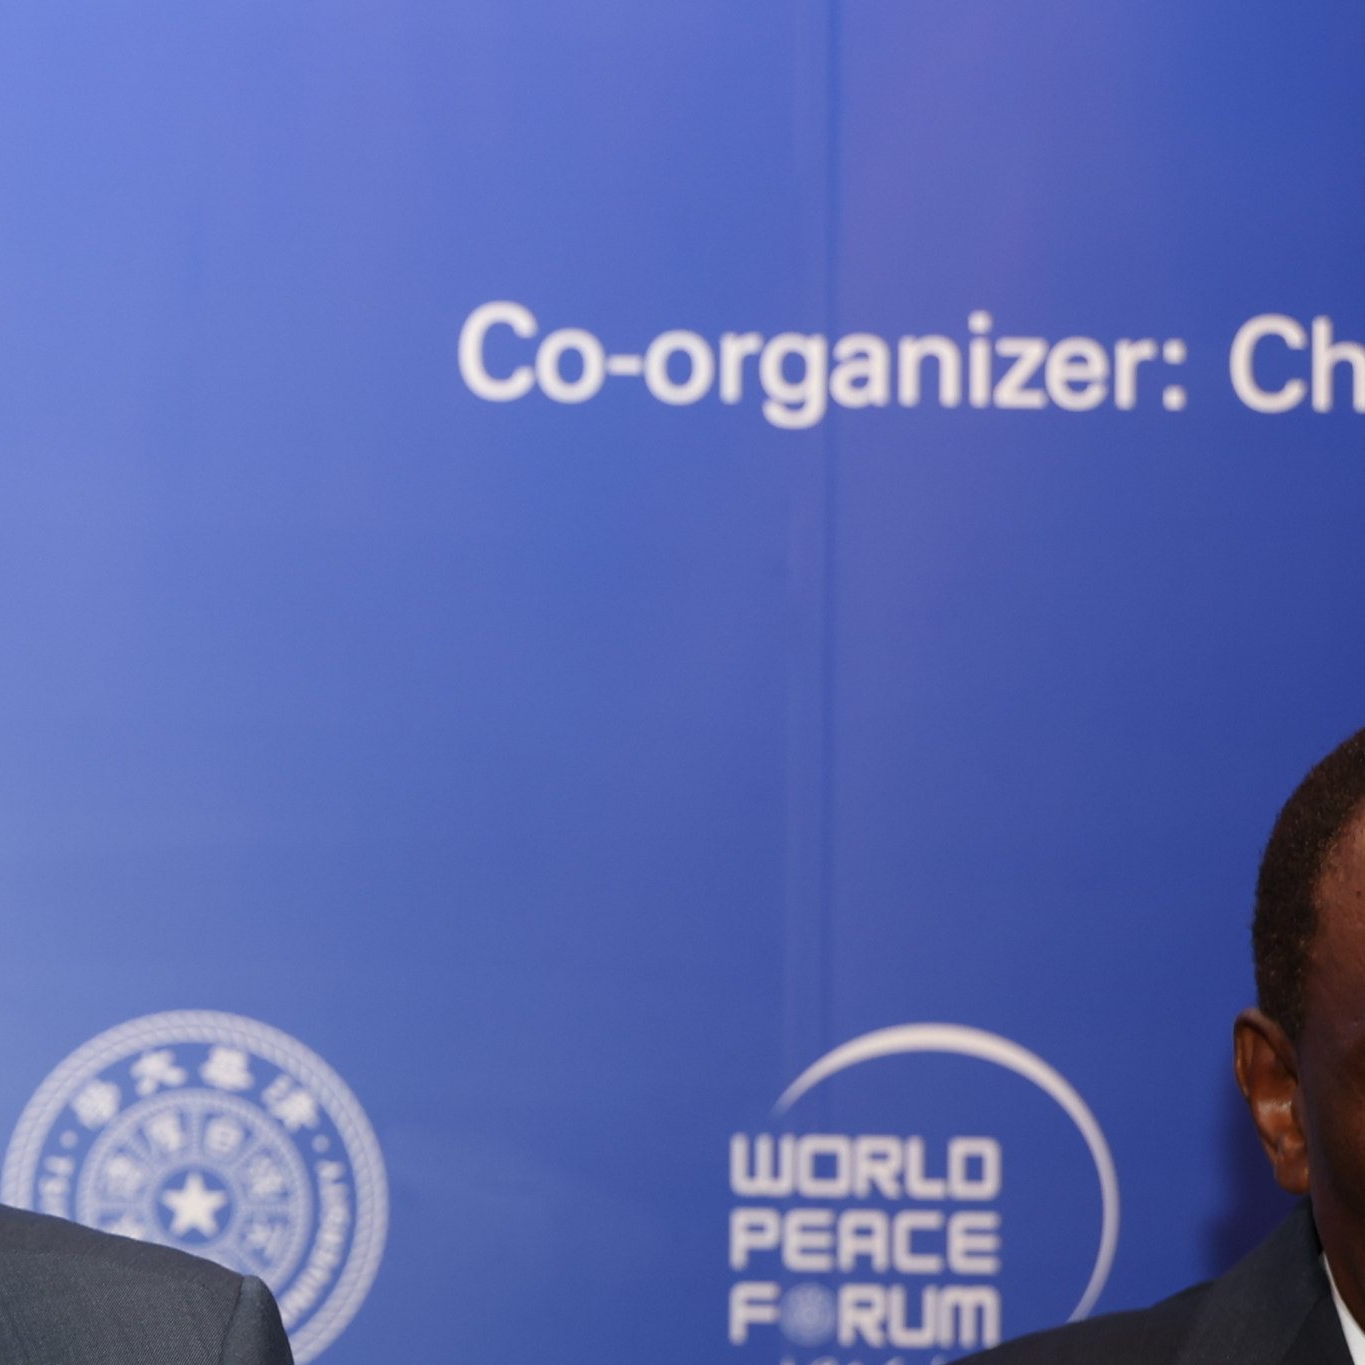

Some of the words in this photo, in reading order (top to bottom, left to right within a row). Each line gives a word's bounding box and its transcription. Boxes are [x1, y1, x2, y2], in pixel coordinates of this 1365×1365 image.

[458, 300, 1187, 430] Co-organizer:
[729, 1132, 1002, 1200] WORLD
[729, 1206, 1001, 1275] PEACE
